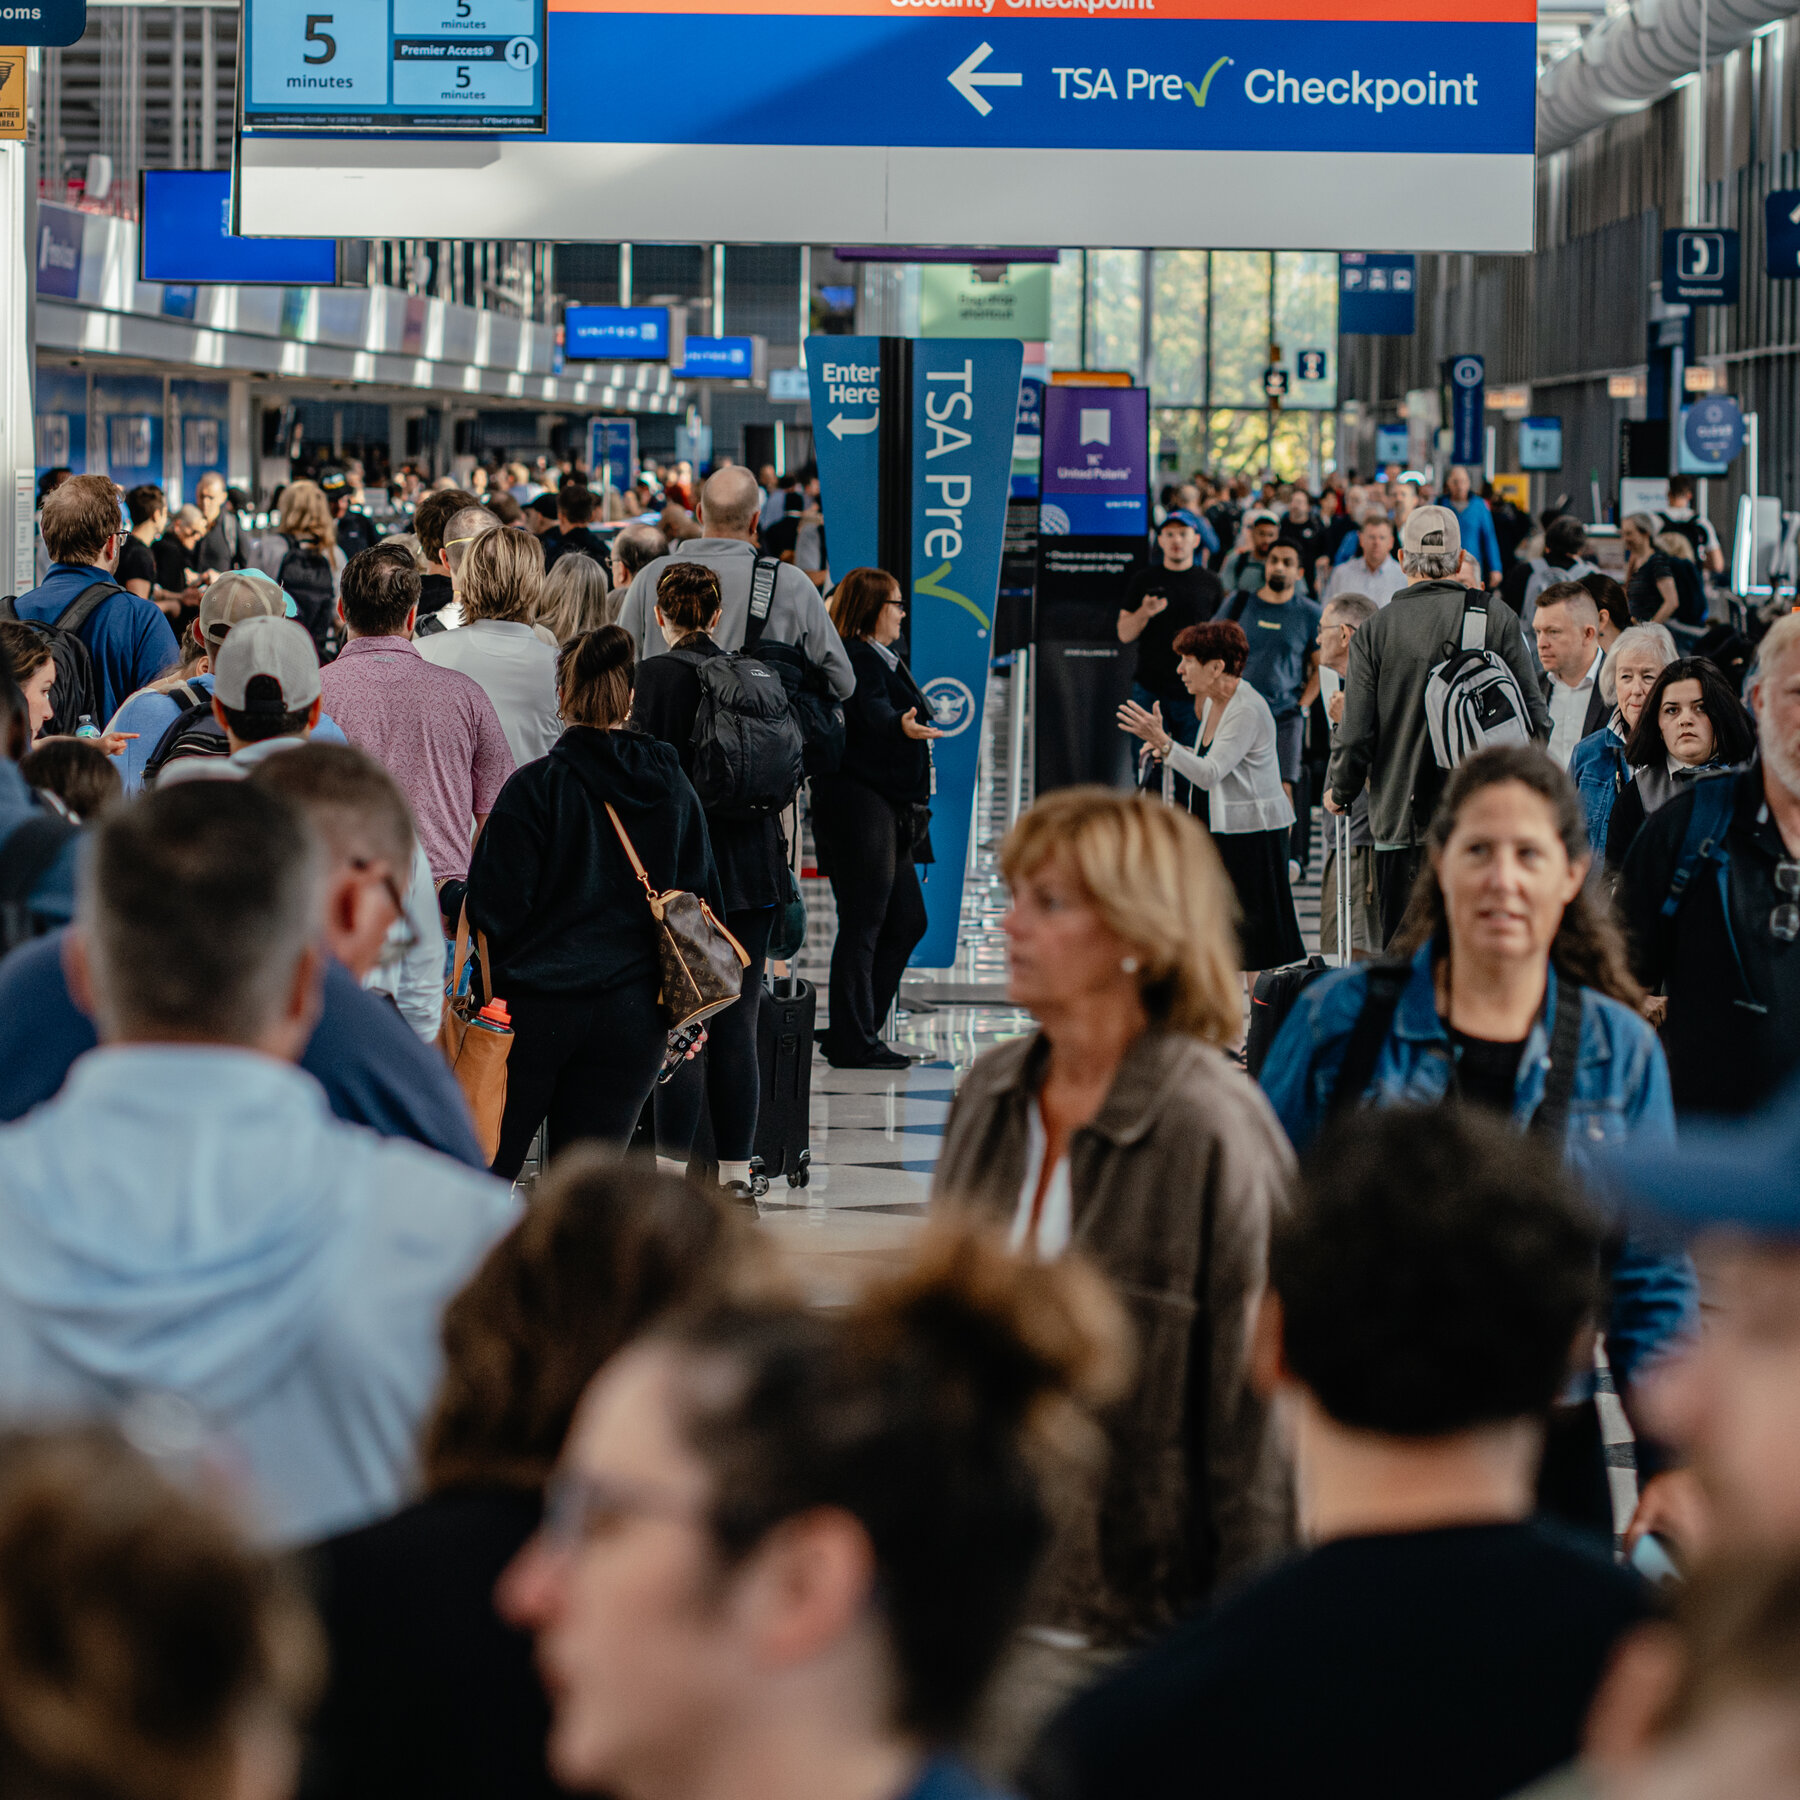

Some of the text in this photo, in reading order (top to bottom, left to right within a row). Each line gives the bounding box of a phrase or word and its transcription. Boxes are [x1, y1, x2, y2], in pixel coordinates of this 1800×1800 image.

[0, 8, 42, 20] oms
[456, 0, 471, 18] 5
[441, 19, 486, 29] minutes
[303, 14, 337, 65] 5
[401, 45, 446, 56] Premier
[286, 74, 353, 88] minutes
[456, 65, 471, 88] 5
[441, 90, 486, 100] minutes
[1051, 67, 1118, 100] TSA
[1244, 68, 1479, 113] Checkpoint
[822, 362, 881, 383] Enter
[829, 384, 880, 404] Here
[925, 359, 973, 460] TSA
